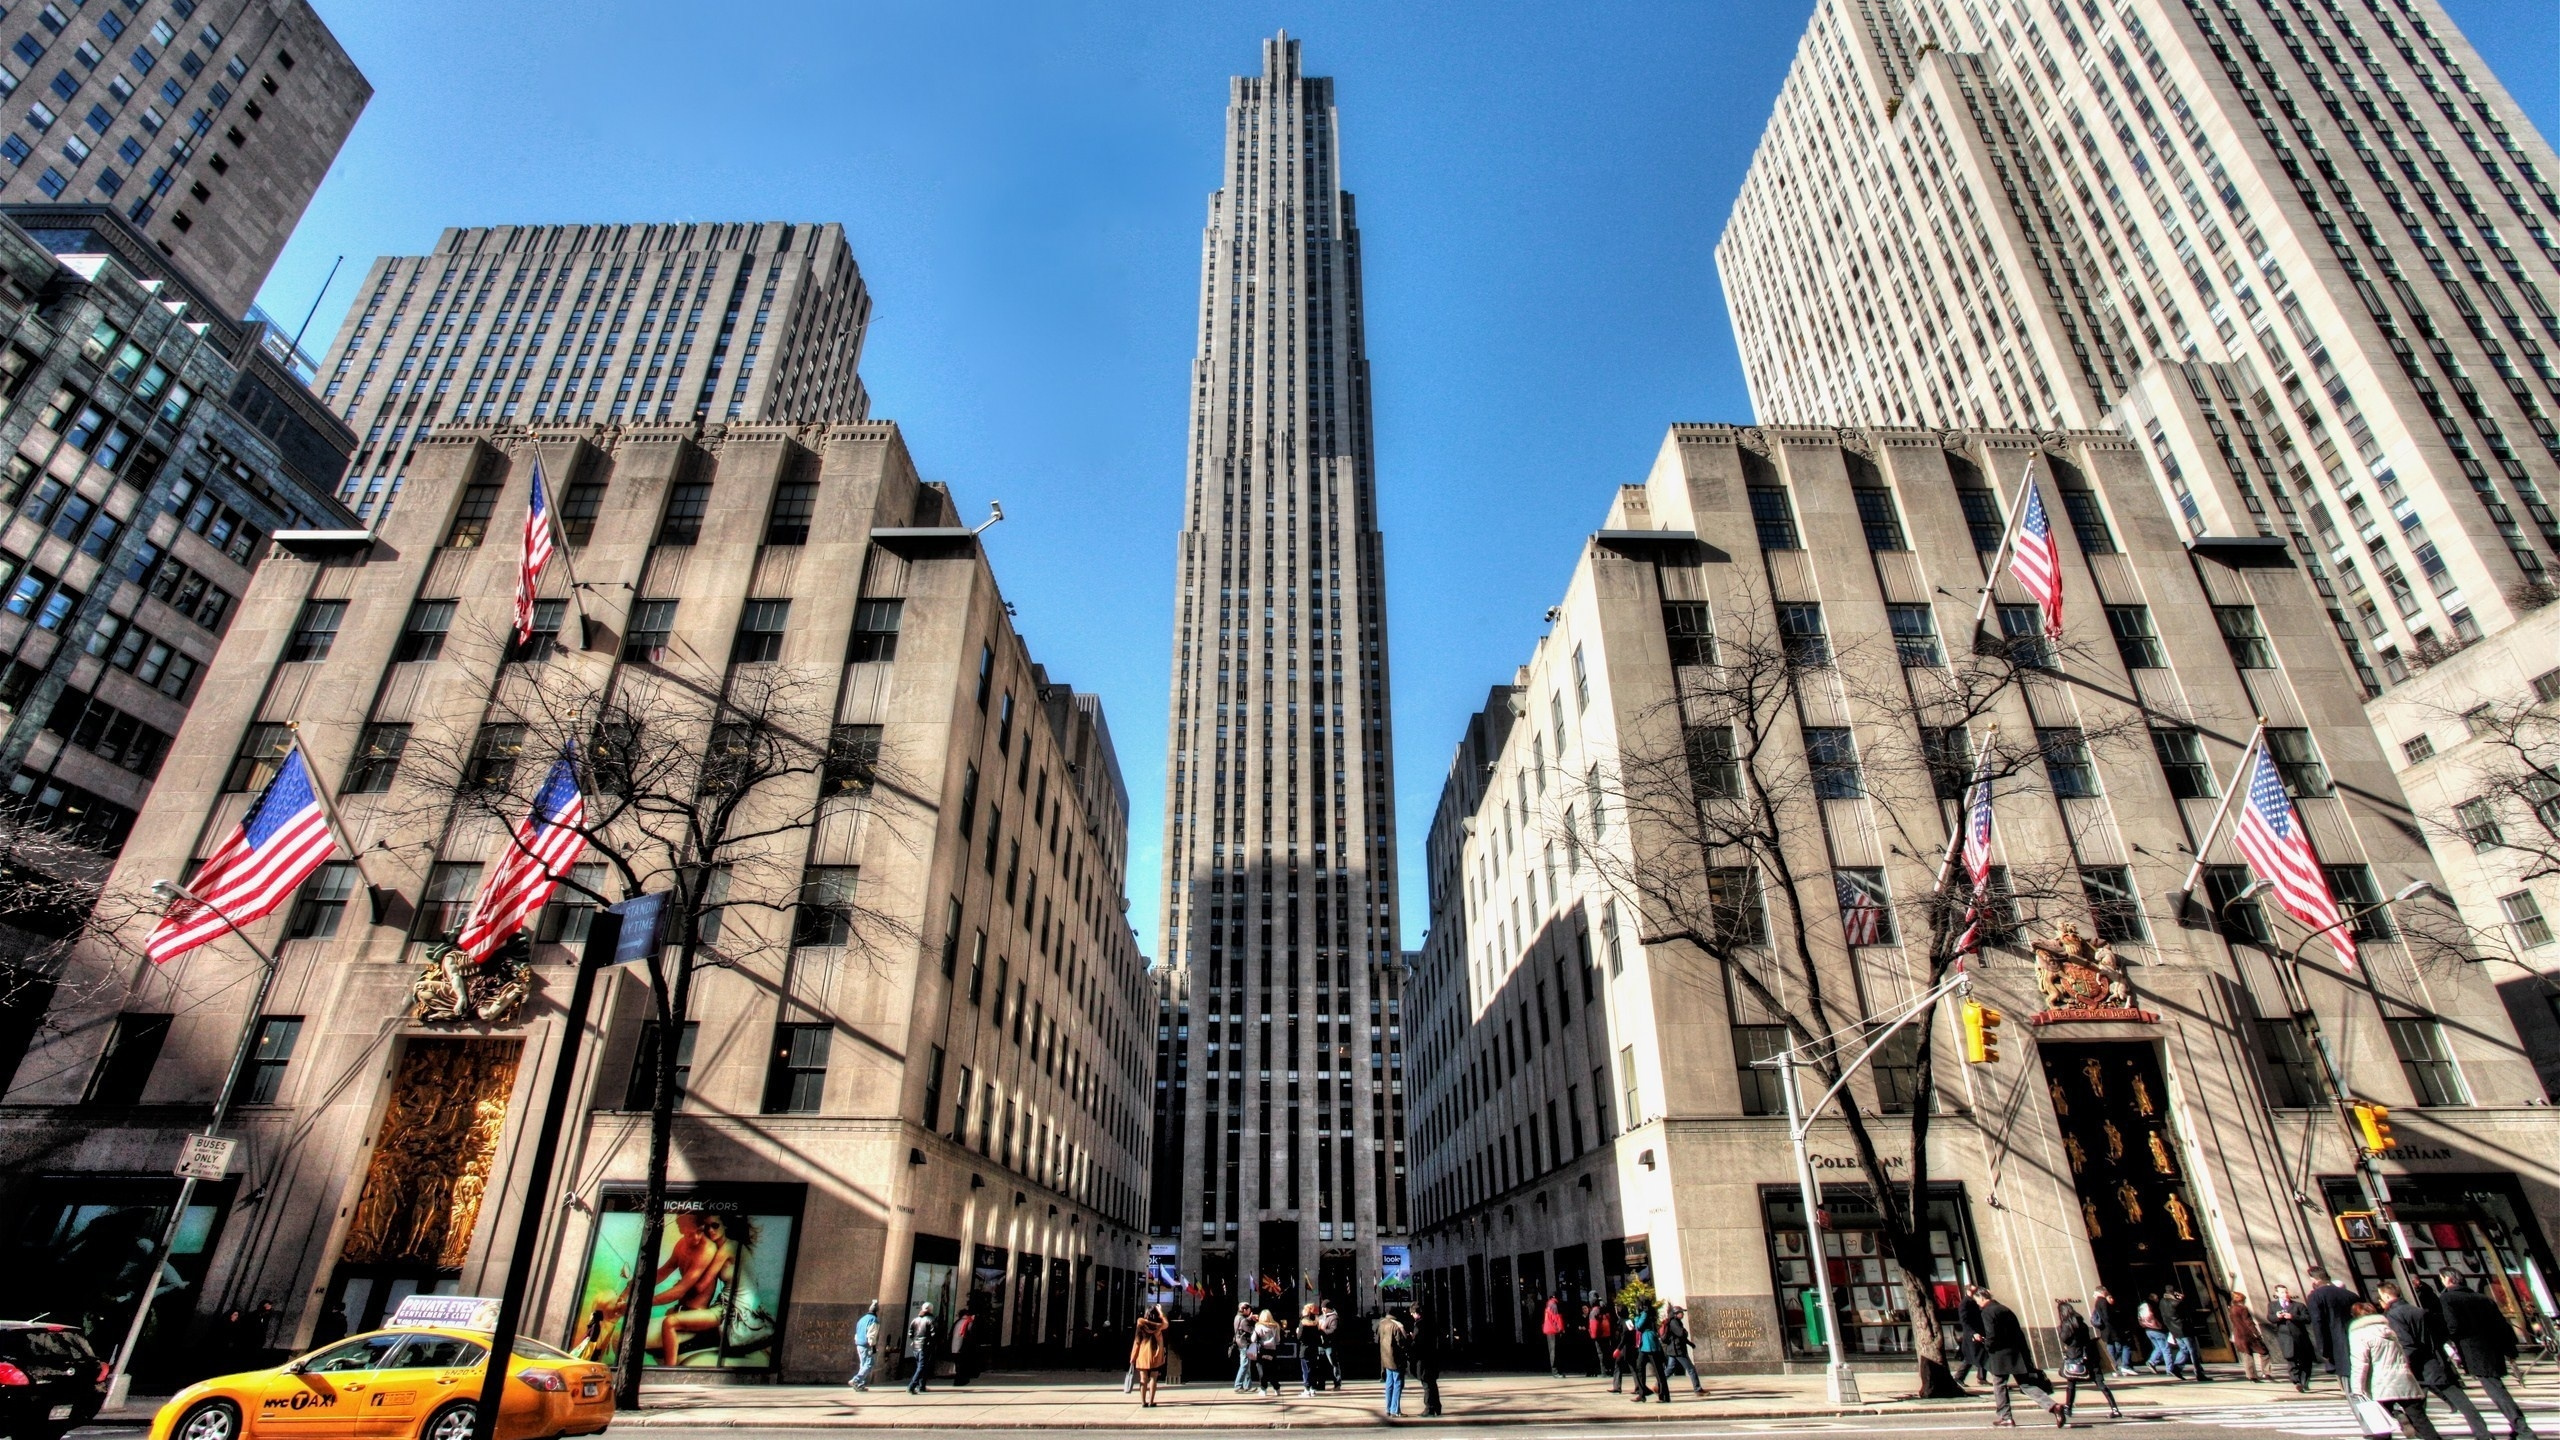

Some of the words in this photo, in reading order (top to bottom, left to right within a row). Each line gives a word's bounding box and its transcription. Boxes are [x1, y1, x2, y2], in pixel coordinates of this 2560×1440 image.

[622, 917, 656, 936] YTIME
[196, 1138, 227, 1150] BUSES
[194, 1153, 219, 1164] ONLY
[663, 1200, 705, 1211] ICHAEL
[708, 1202, 739, 1211] KORS
[403, 1299, 449, 1312] PRIVATE
[448, 1300, 478, 1313] EYES
[400, 1311, 450, 1319] GENTLEMEN'S
[451, 1312, 470, 1320] CLUB
[263, 1398, 290, 1409] NYC
[290, 1390, 337, 1411] TAXI
